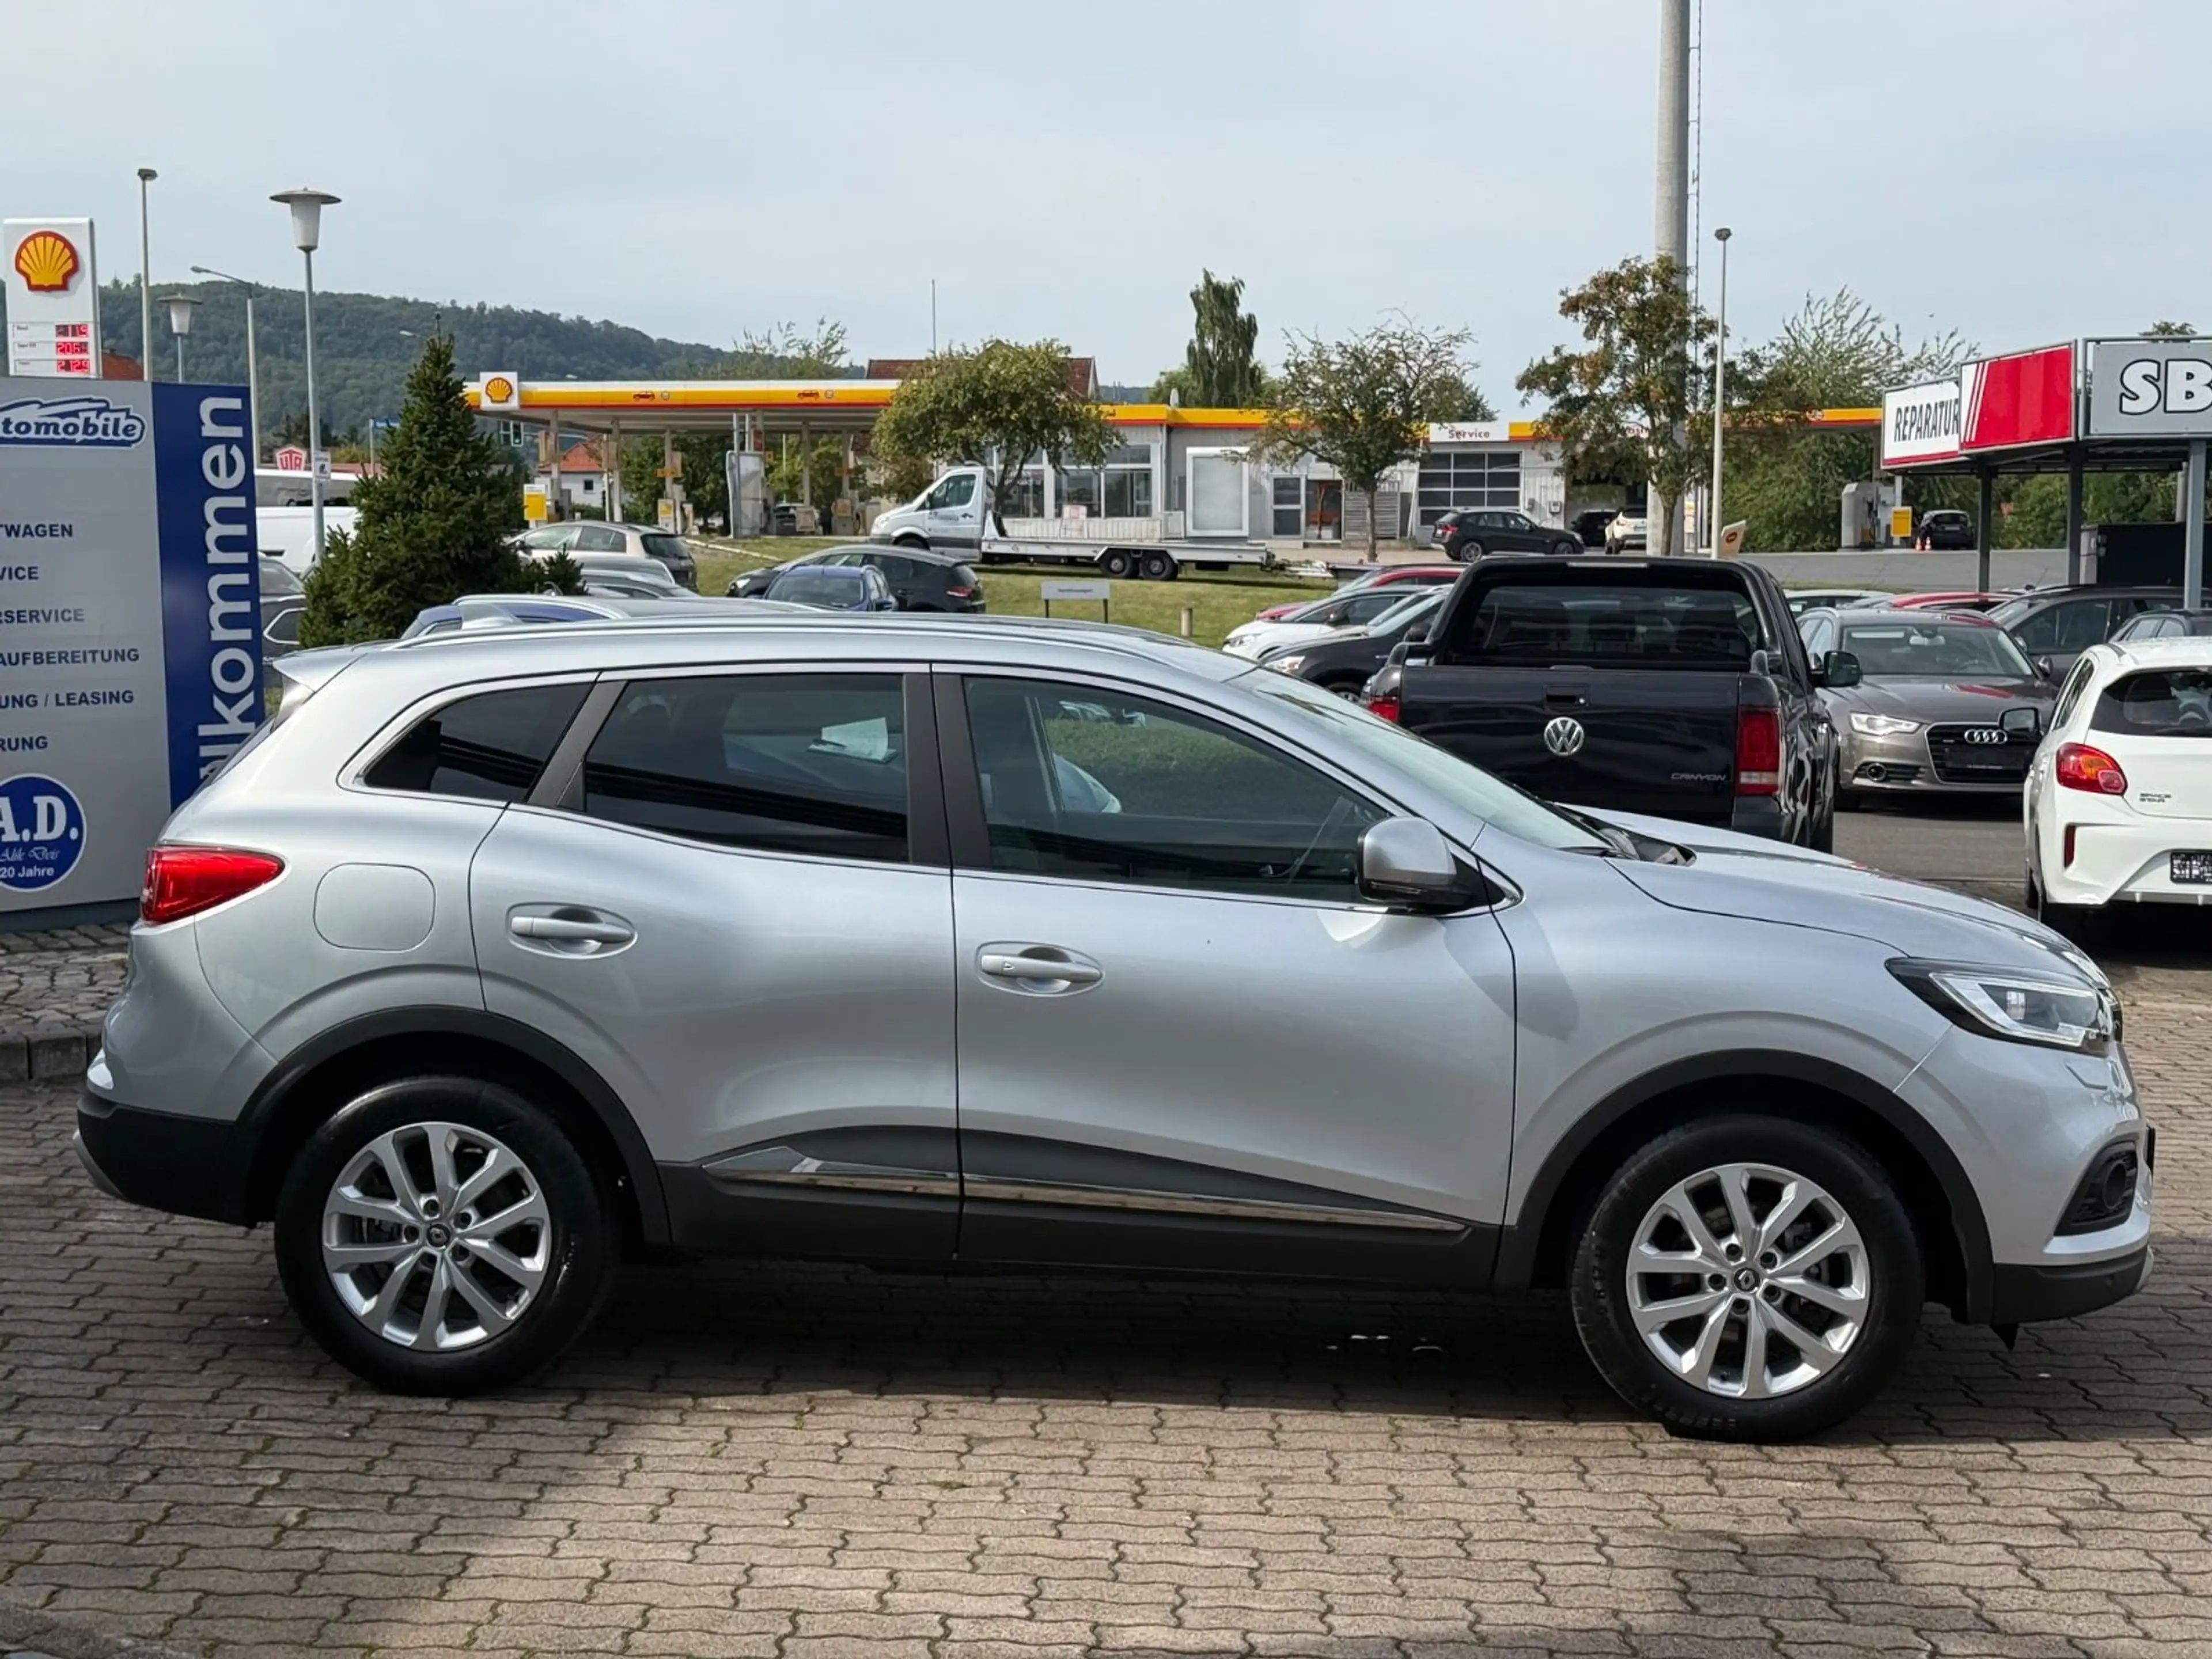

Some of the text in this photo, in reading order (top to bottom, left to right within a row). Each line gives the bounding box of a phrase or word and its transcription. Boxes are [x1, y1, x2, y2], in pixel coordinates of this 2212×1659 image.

[2119, 358, 2212, 416] SB
[1, 416, 137, 437] tomobile
[1893, 398, 1959, 442] REPARATUR
[1449, 428, 1490, 439] Service
[198, 396, 256, 780] lkommen
[0, 608, 85, 624] SERVICE
[55, 690, 134, 707] LEASING
[1671, 772, 1726, 781] CANYON
[17, 865, 55, 877] Jahre
